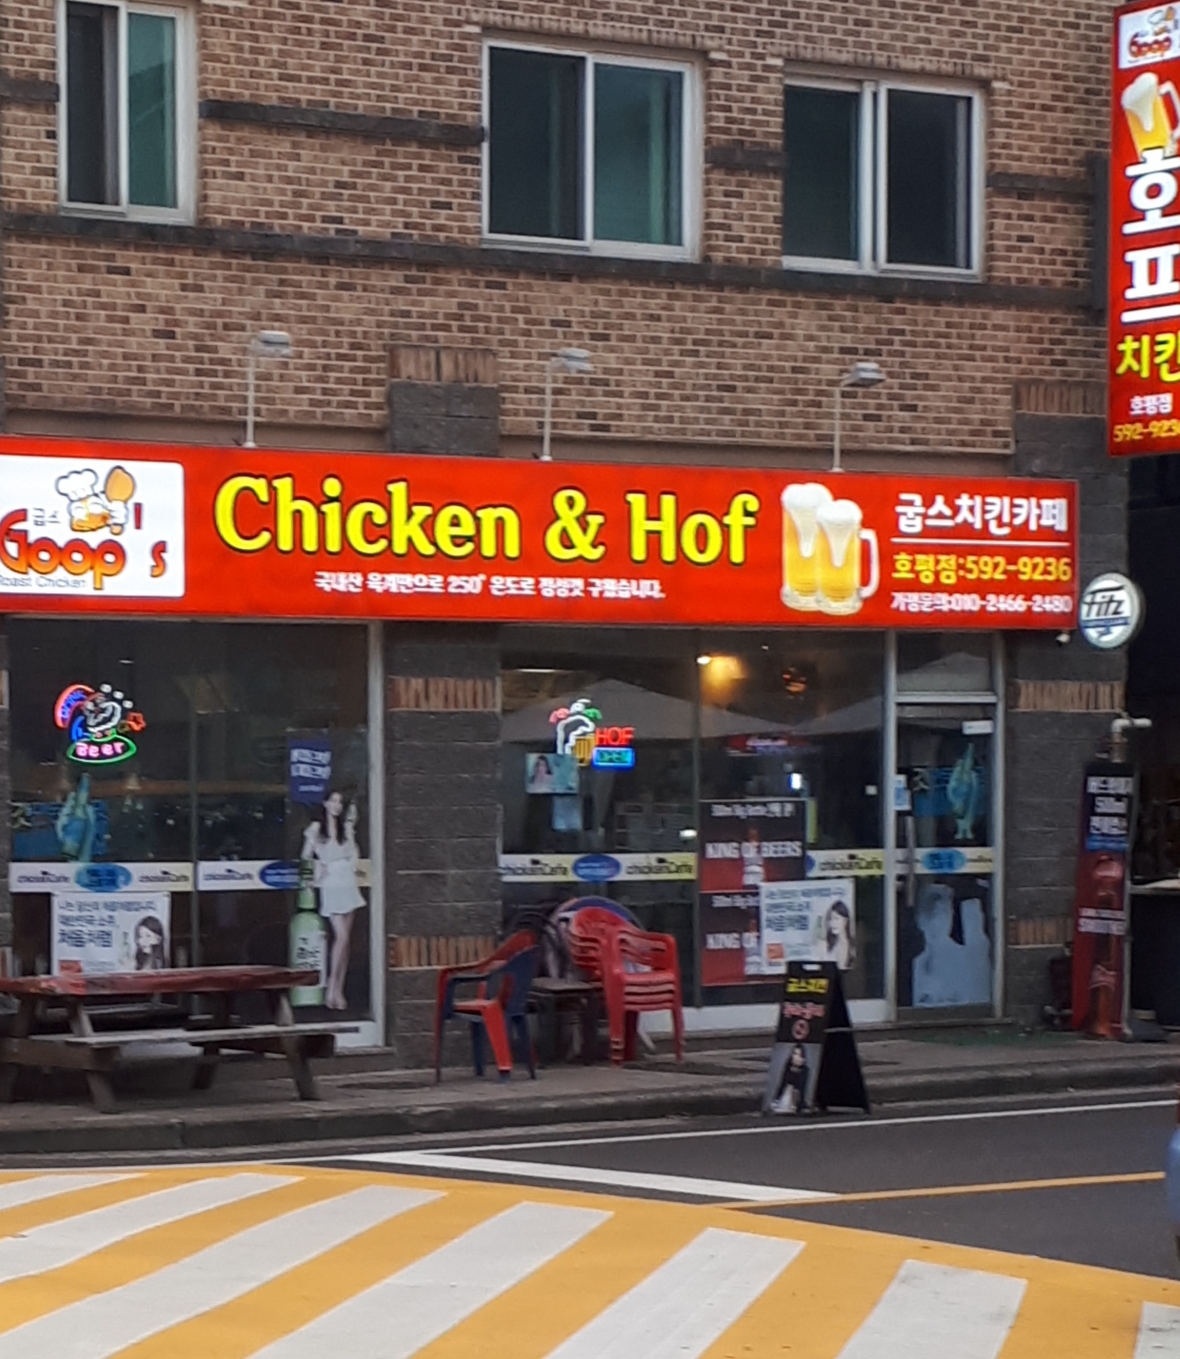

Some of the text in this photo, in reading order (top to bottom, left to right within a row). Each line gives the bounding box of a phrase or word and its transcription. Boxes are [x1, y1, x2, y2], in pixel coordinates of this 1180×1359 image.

[1129, 392, 1173, 416] 호평점
[1113, 418, 1180, 442] 592-923
[214, 474, 760, 564] Chicken & Hof
[895, 493, 1069, 536] 굽스치킨카페
[314, 571, 363, 593] 국내산
[489, 575, 536, 595] 온도로
[595, 727, 634, 745] HOF
[705, 842, 740, 859] KING
